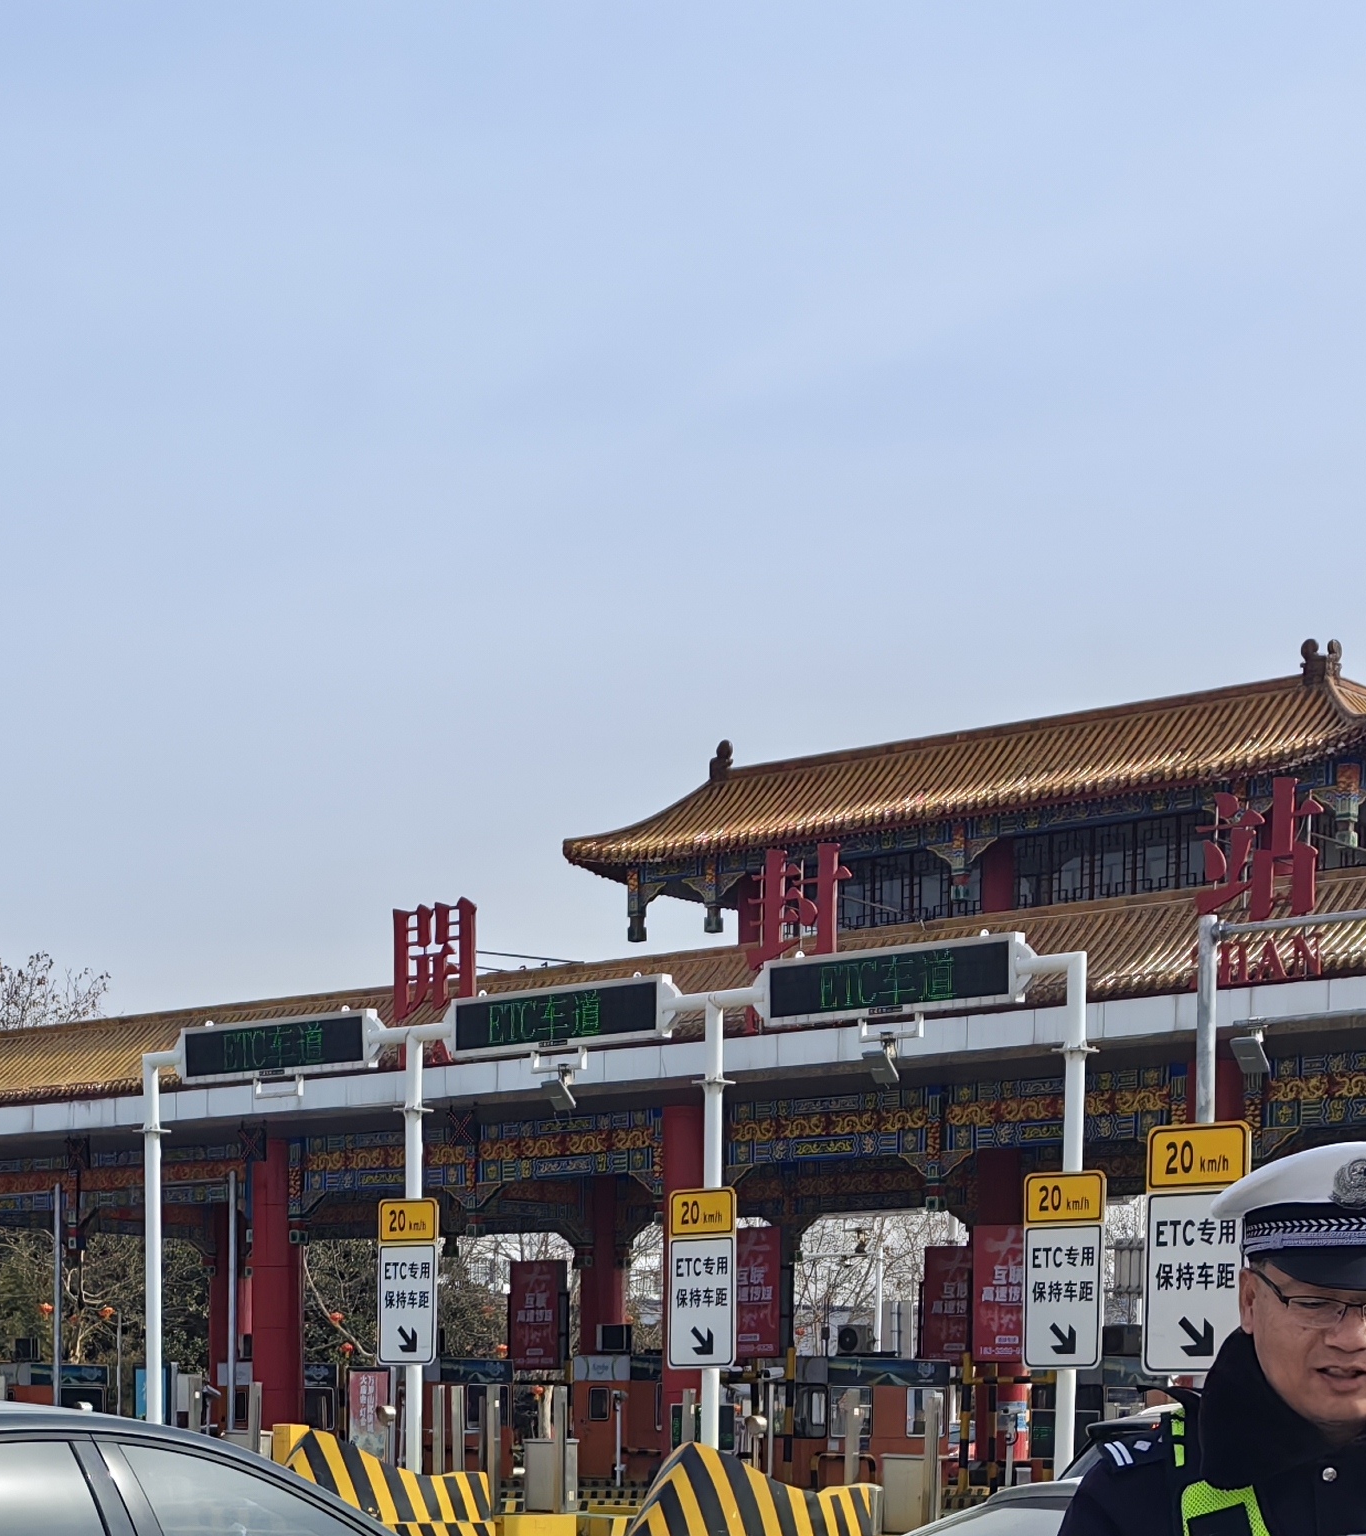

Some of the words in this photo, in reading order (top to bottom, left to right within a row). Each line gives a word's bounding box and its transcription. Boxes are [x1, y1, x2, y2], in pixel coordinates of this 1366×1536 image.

[1191, 932, 1323, 989] HAN
[820, 948, 955, 1009] ETC车道
[488, 989, 601, 1044] ETC车道
[223, 1021, 325, 1070] ETC车道
[1165, 1140, 1194, 1174] 20
[1200, 1155, 1229, 1173] km/h
[1039, 1185, 1061, 1211] 20
[1066, 1196, 1090, 1211] km/h
[389, 1209, 406, 1232] 20
[409, 1218, 426, 1231] km/h
[681, 1201, 700, 1225] 20
[703, 1212, 723, 1224] km/h
[1156, 1218, 1235, 1247] ETC专用
[676, 1256, 728, 1277] ETC专用
[1032, 1246, 1095, 1268] ETC专用
[385, 1261, 430, 1280] ETC专用
[1156, 1262, 1235, 1291] 保持车距
[385, 1290, 429, 1309] 保持车距
[676, 1287, 728, 1308] 保持车距
[981, 1286, 1024, 1302] 高速传
[1032, 1280, 1094, 1303] 保持车距
